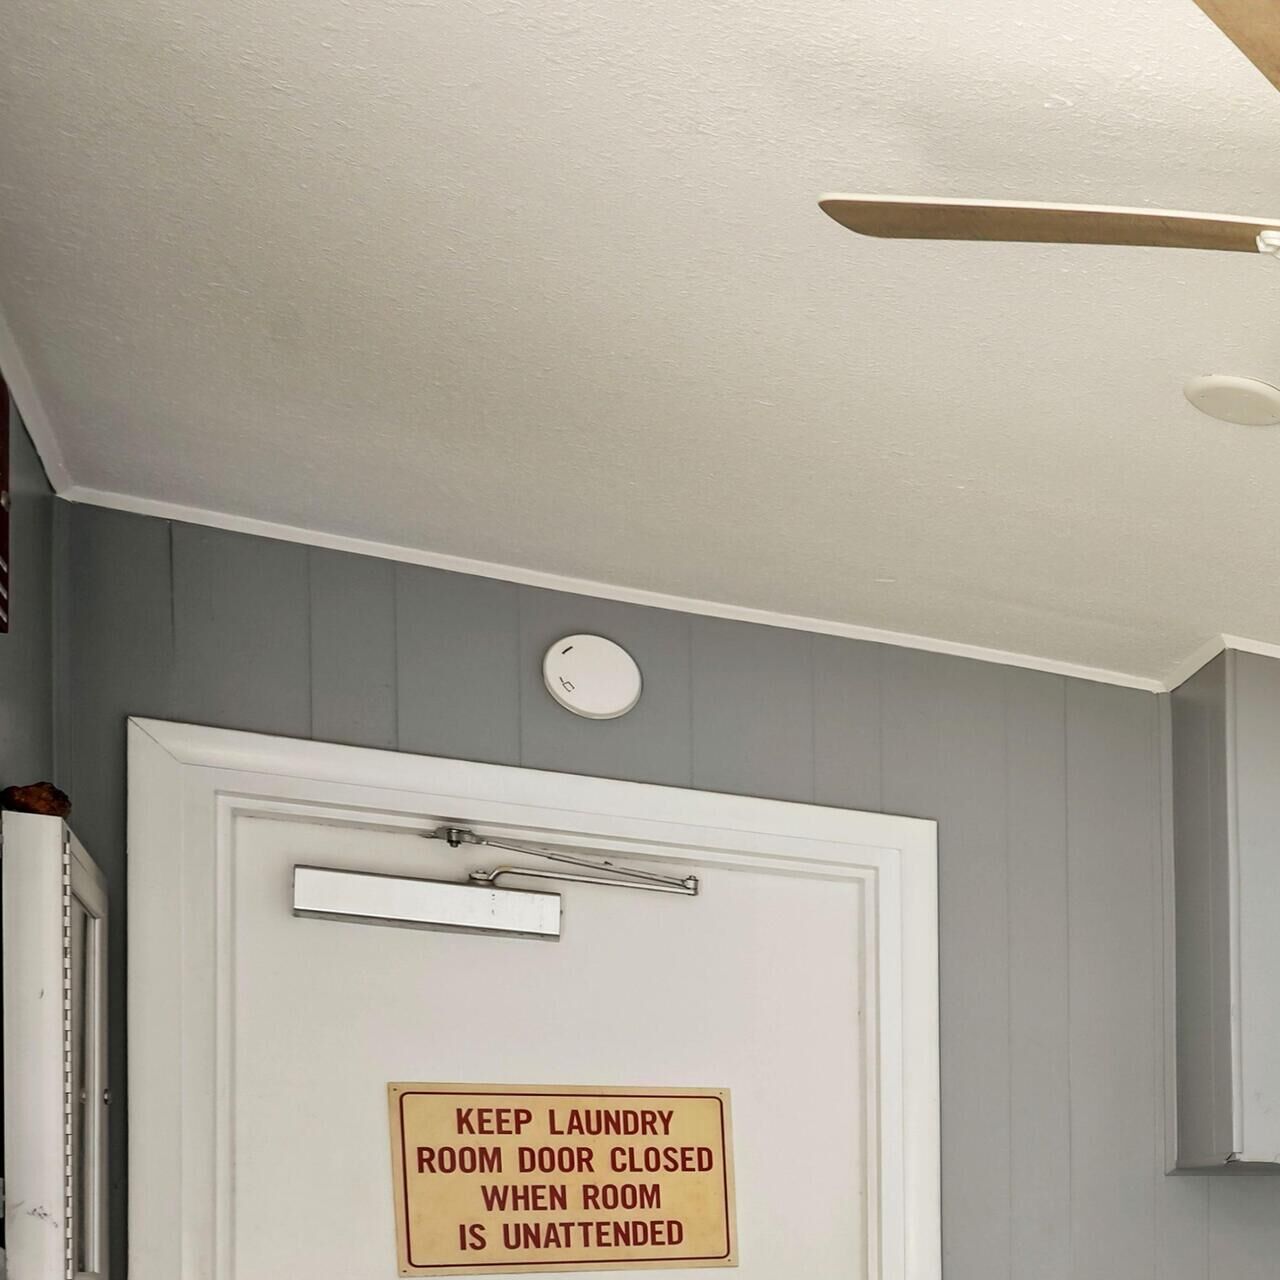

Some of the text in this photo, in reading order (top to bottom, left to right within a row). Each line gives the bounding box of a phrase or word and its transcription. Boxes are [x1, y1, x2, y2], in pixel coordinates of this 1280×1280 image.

[457, 1108, 674, 1135] KEEP LAUNDRY
[417, 1147, 713, 1173] ROOM DOOR CLOSED
[481, 1184, 661, 1211] WHEN ROOM
[459, 1220, 683, 1250] IS UNATTENDED
